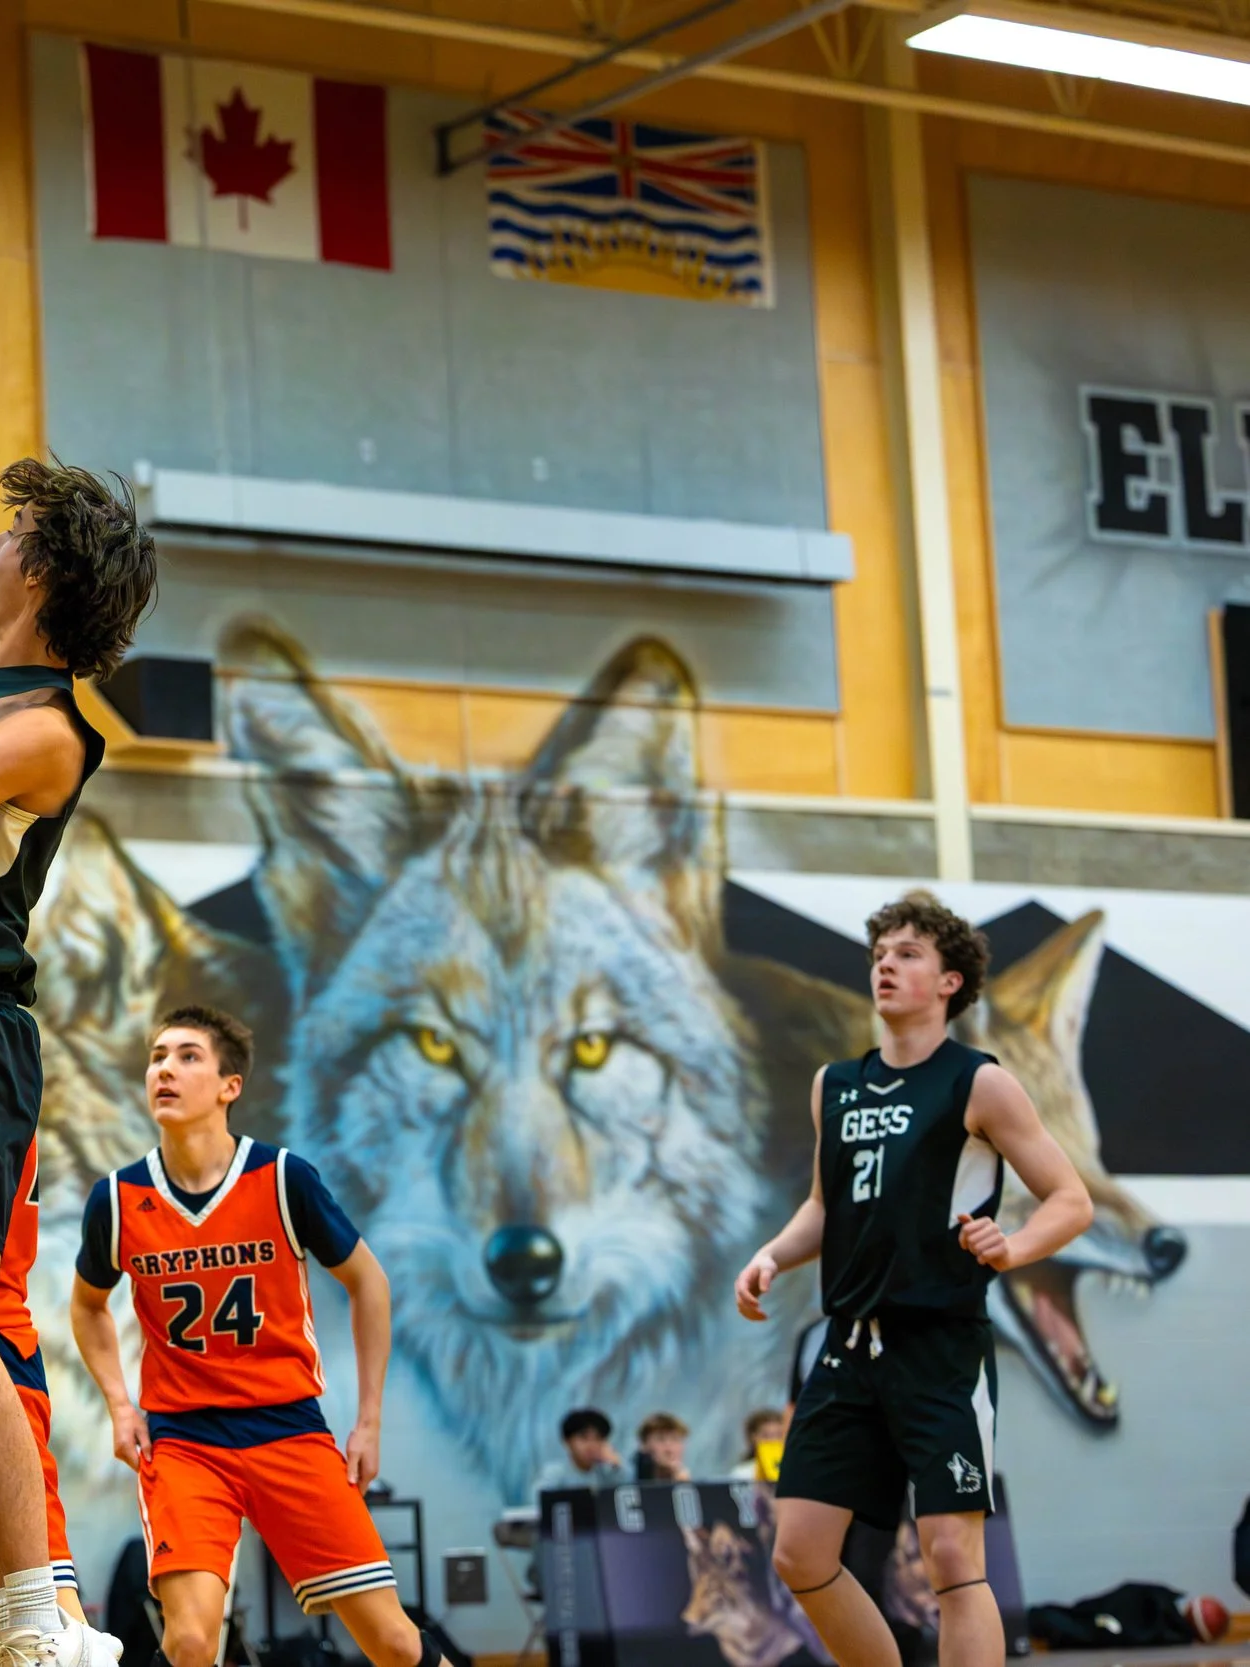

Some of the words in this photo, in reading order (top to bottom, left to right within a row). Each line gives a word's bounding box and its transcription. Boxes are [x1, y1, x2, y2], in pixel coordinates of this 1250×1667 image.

[1078, 384, 1250, 553] EL
[840, 1104, 914, 1143] GESS
[851, 1144, 885, 1203] 21
[130, 1239, 275, 1277] GRYPHONS
[161, 1274, 265, 1354] 24
